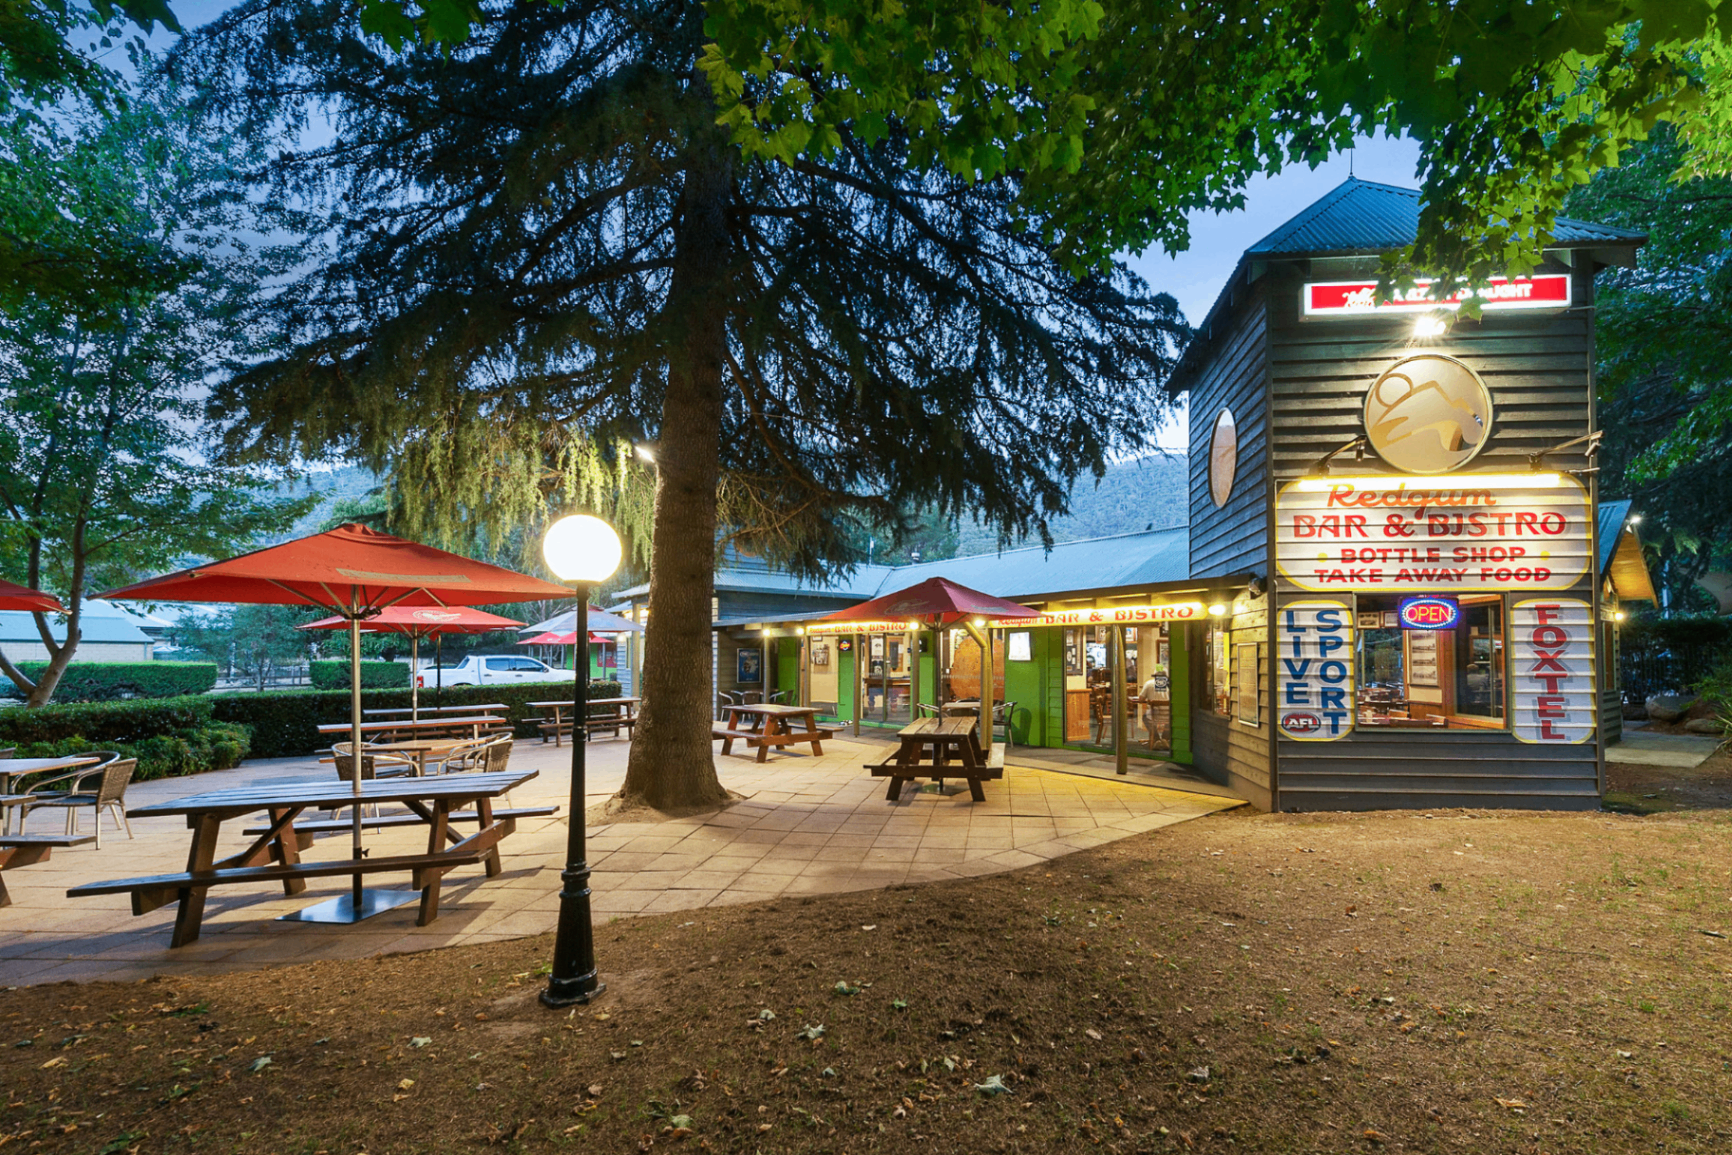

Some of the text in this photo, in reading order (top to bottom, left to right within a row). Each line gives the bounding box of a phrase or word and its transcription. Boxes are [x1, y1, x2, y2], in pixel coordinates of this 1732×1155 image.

[1327, 482, 1497, 520] Redgum
[1293, 511, 1567, 538] BAR & BISTRO
[1341, 546, 1526, 564] BOTTLE SHOP
[1314, 566, 1551, 583] TAKE AWAY FOOD
[1045, 612, 1080, 625] BAR
[1089, 611, 1103, 622] &
[1115, 606, 1194, 621] BISTRO
[1405, 606, 1452, 622] OPEN
[1283, 610, 1312, 704] LIVE
[1316, 609, 1348, 734] SPORT
[1531, 604, 1568, 740] FOXTEL
[1285, 717, 1319, 729] AFL
